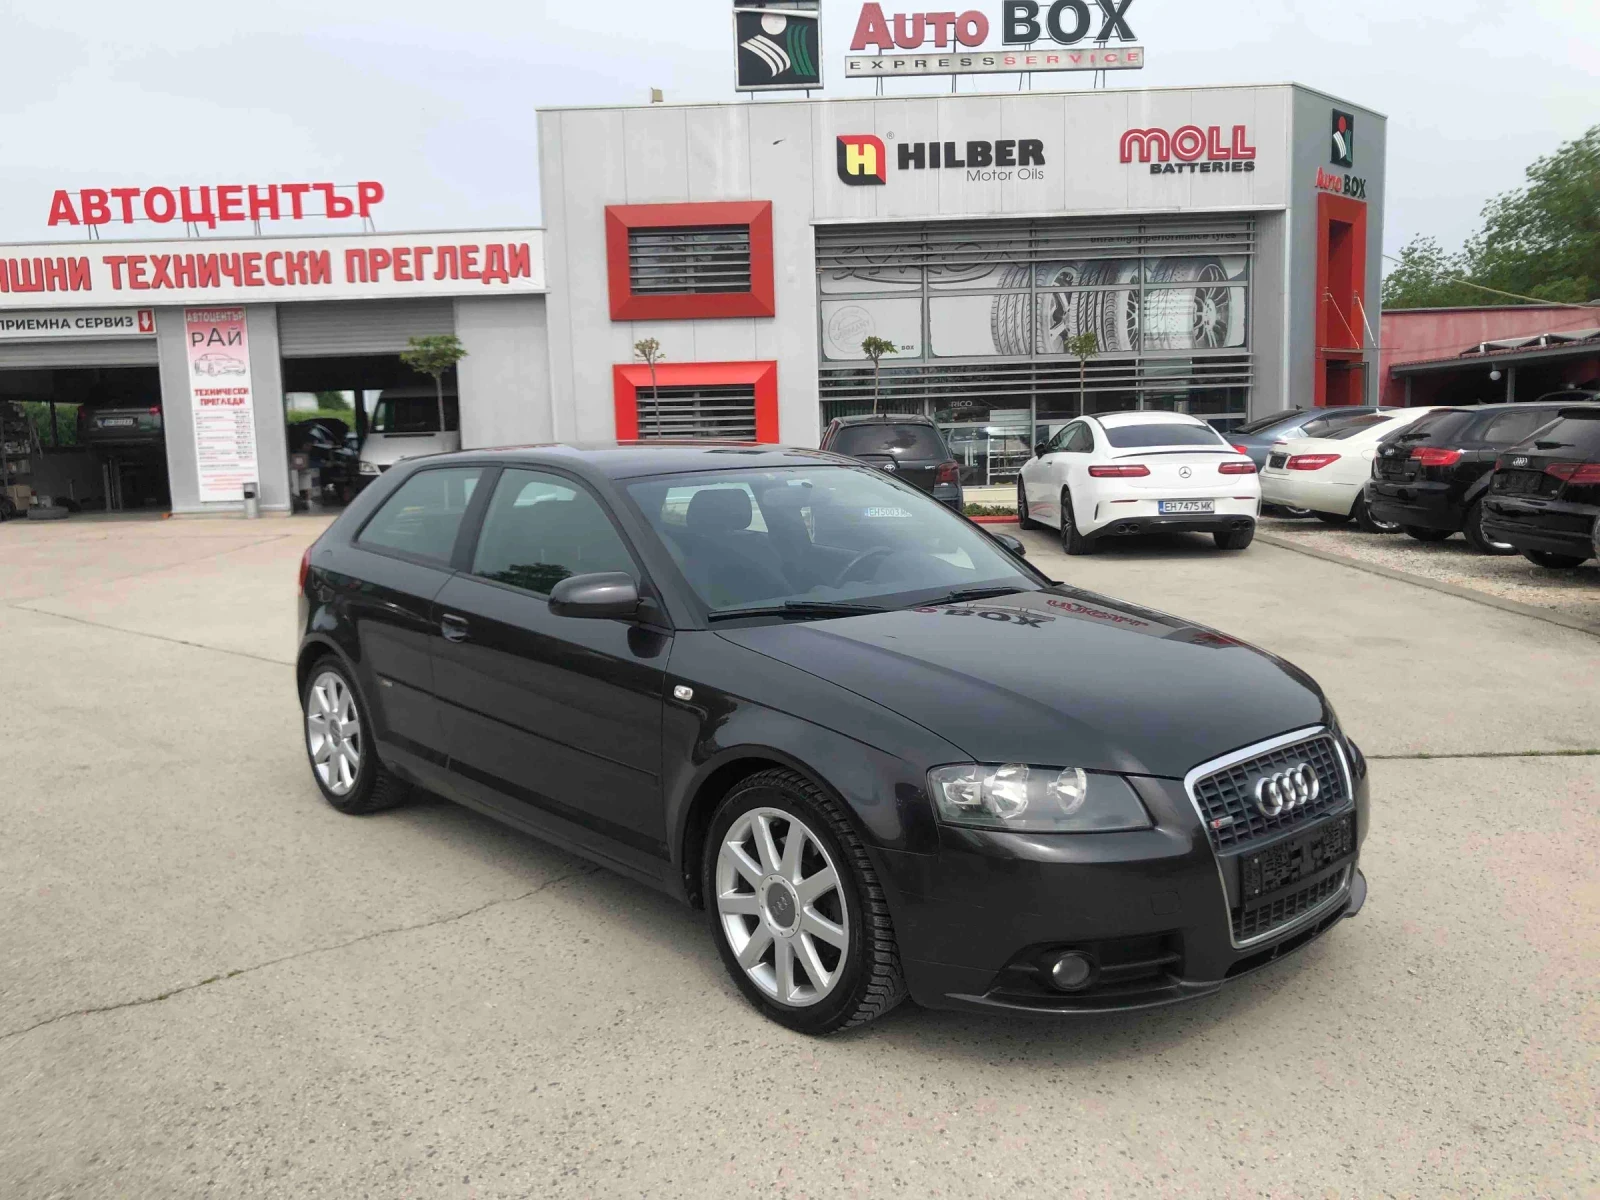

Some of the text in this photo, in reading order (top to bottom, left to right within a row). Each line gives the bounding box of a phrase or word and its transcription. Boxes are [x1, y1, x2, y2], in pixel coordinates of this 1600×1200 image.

[1002, 0, 1138, 46] BOX
[897, 139, 1046, 170] HILBER
[1150, 161, 1255, 174] BATTERIES
[966, 168, 1044, 182] Motor Oils
[1342, 174, 1366, 199] BOX
[47, 181, 384, 229] АВТОЦЕНТЪР
[103, 250, 332, 291] ТЕХНИЧЕСКИ
[345, 243, 531, 284] ПРЕГЛЕДИ
[75, 316, 134, 329] СЕРВИЗ
[187, 311, 245, 323] АВТОЦЕНТЪР
[191, 326, 243, 348] РАЙ
[194, 387, 250, 397] ТЕХНИЧЕСКИ
[200, 397, 246, 406] ПРЕГЛЕДИ
[1178, 501, 1200, 511] 7475
